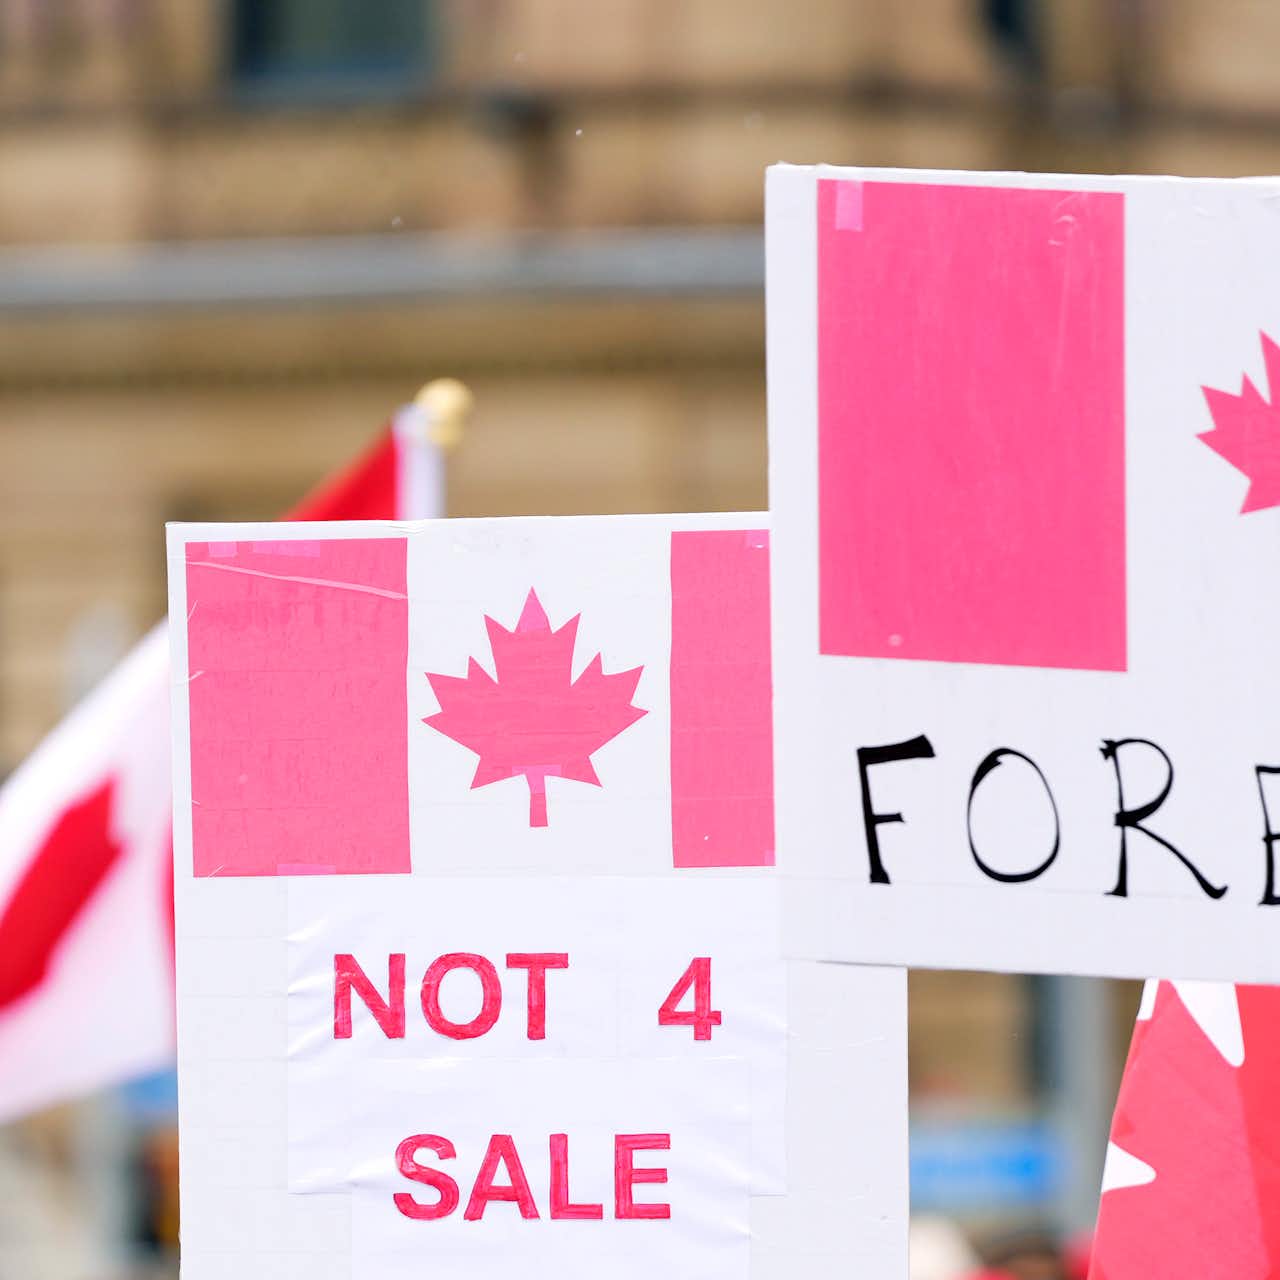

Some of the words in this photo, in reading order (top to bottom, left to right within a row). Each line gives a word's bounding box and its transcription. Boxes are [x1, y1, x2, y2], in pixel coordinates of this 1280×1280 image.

[332, 950, 571, 1042] NOT
[656, 953, 724, 1042] 4
[391, 1131, 673, 1223] SALE
